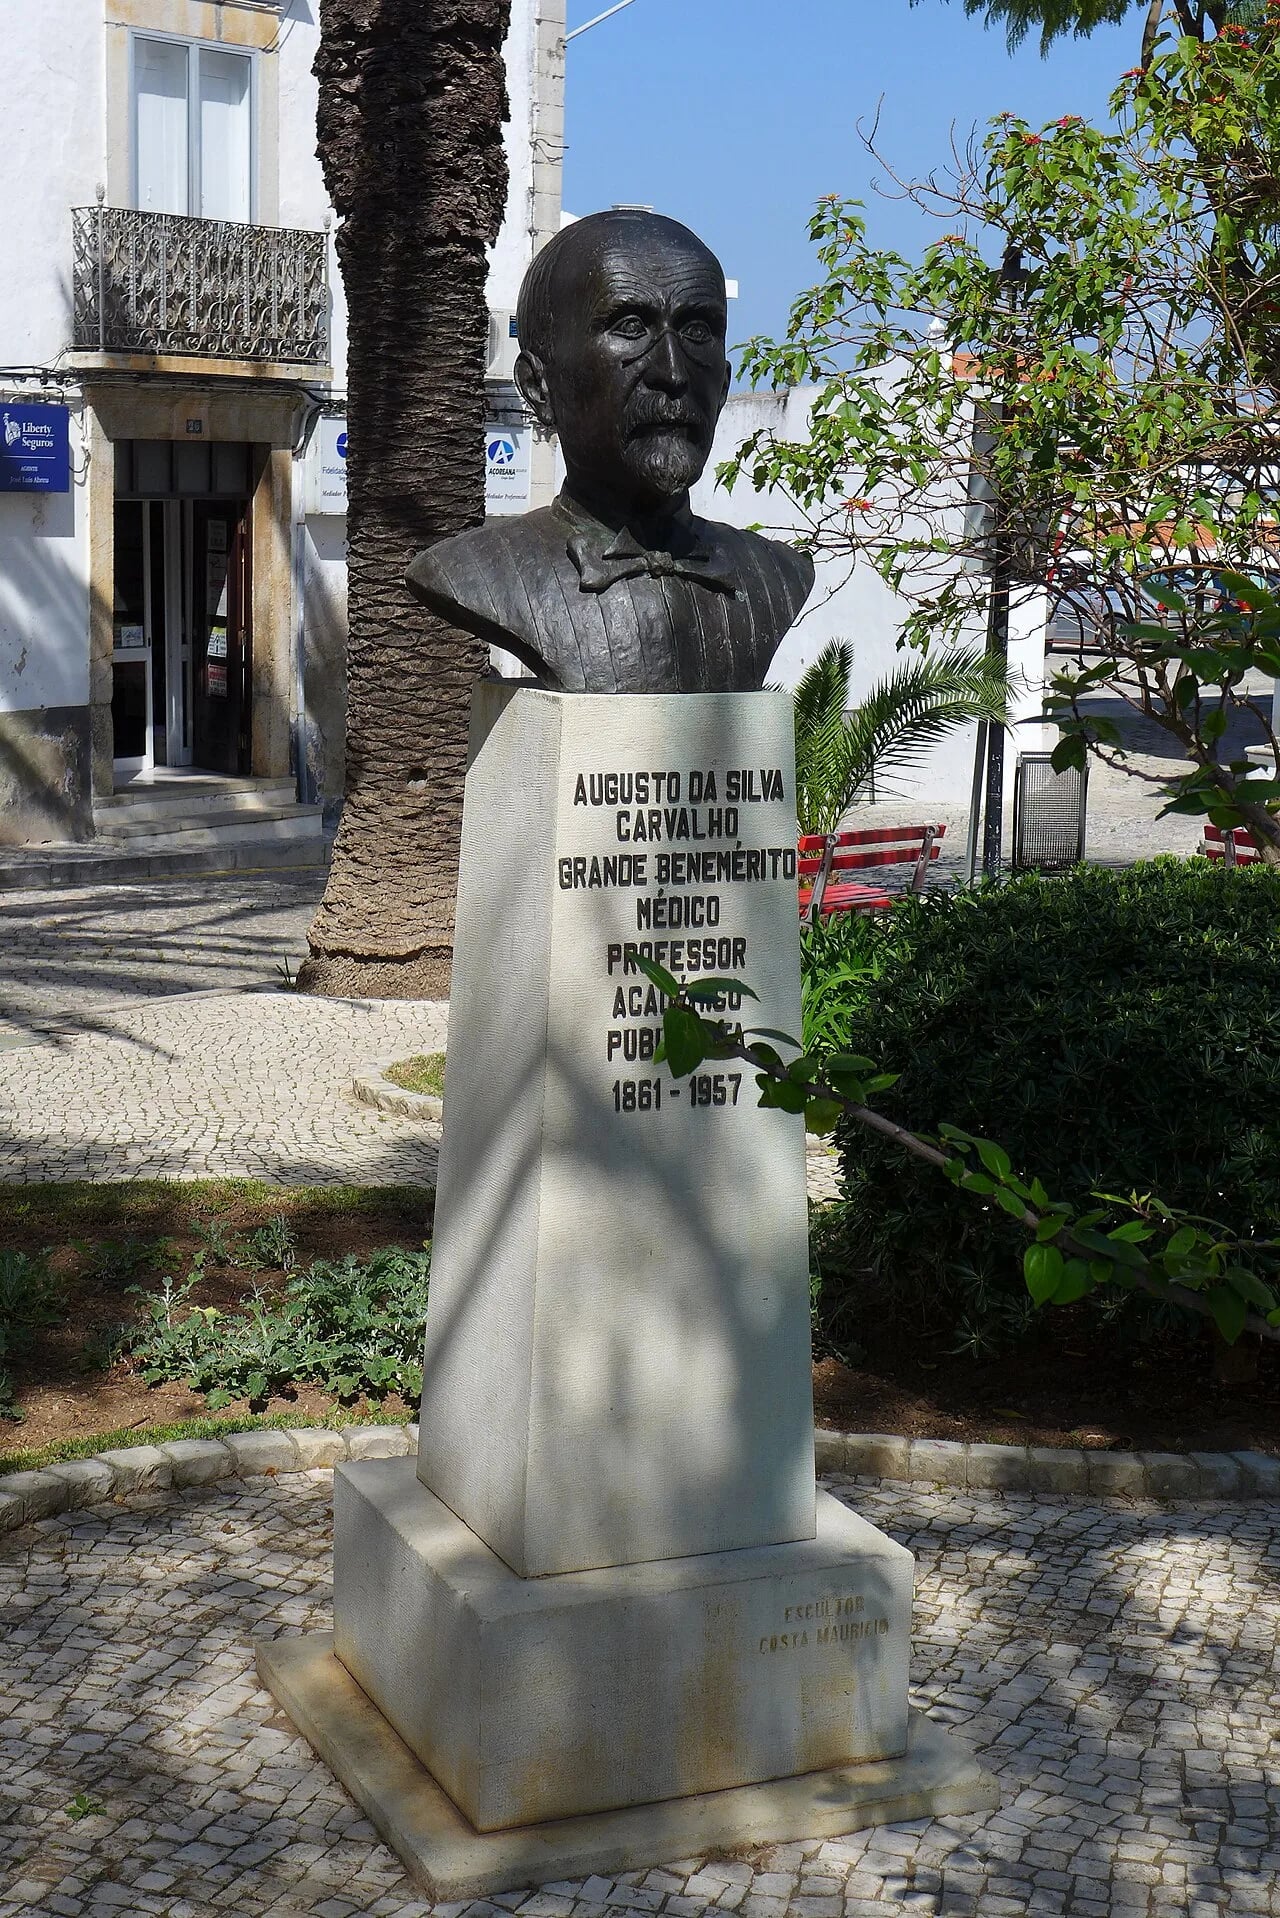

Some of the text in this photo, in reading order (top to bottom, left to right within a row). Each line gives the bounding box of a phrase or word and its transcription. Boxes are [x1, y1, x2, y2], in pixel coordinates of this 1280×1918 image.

[22, 422, 54, 437] Liberty
[22, 436, 54, 450] Seguros
[488, 468, 515, 476] AÇOREANA
[573, 769, 785, 806] AUGUSTO DA SILVA
[616, 807, 739, 842] CARVALHO
[558, 840, 797, 889] GRANDE BENEMÉRITO
[636, 888, 720, 931] MÉDICO
[607, 937, 747, 975] PROFESSOR
[611, 1073, 743, 1112] 1861 - 1957
[784, 1595, 865, 1624] ESCULTOR
[759, 1617, 890, 1655] COSTA MAURICIO
